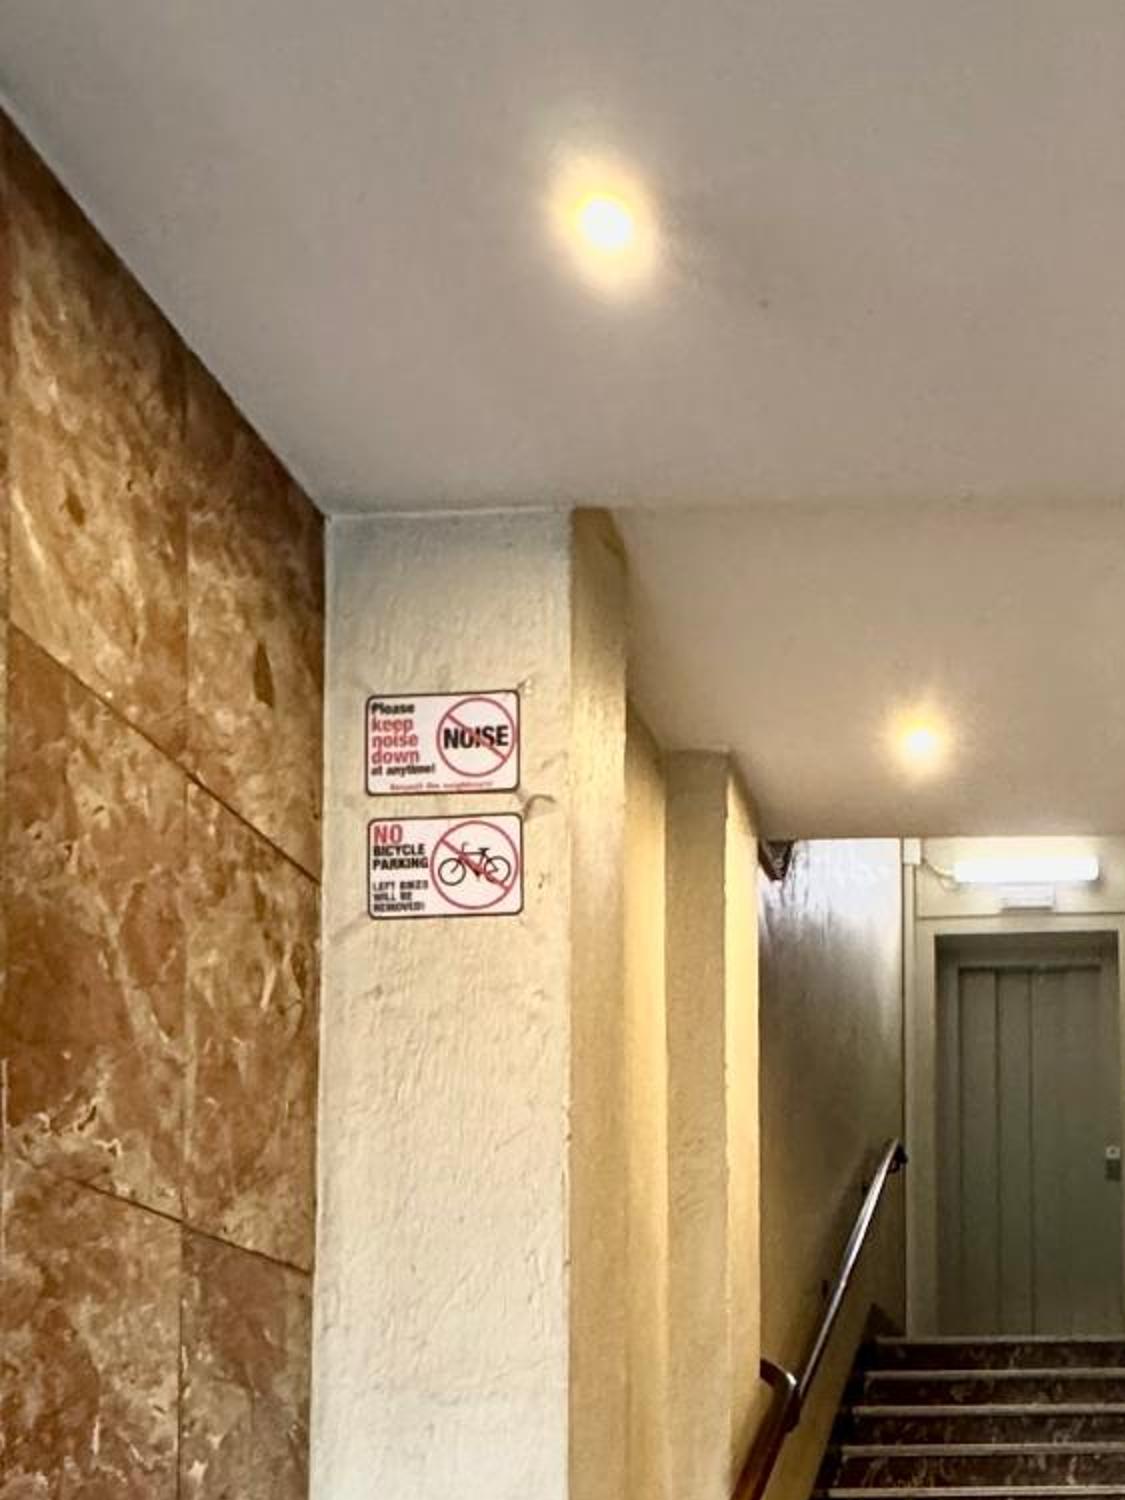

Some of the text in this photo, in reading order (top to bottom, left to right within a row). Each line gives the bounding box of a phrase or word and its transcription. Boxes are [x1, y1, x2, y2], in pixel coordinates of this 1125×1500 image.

[371, 702, 415, 714] Please
[371, 717, 413, 735] keep
[371, 734, 418, 747] noise
[443, 725, 509, 749] NOISE
[371, 747, 419, 764] down
[371, 765, 382, 775] at
[373, 824, 403, 843] NO
[373, 844, 425, 857] BICYCLE
[373, 857, 428, 870] PARKING
